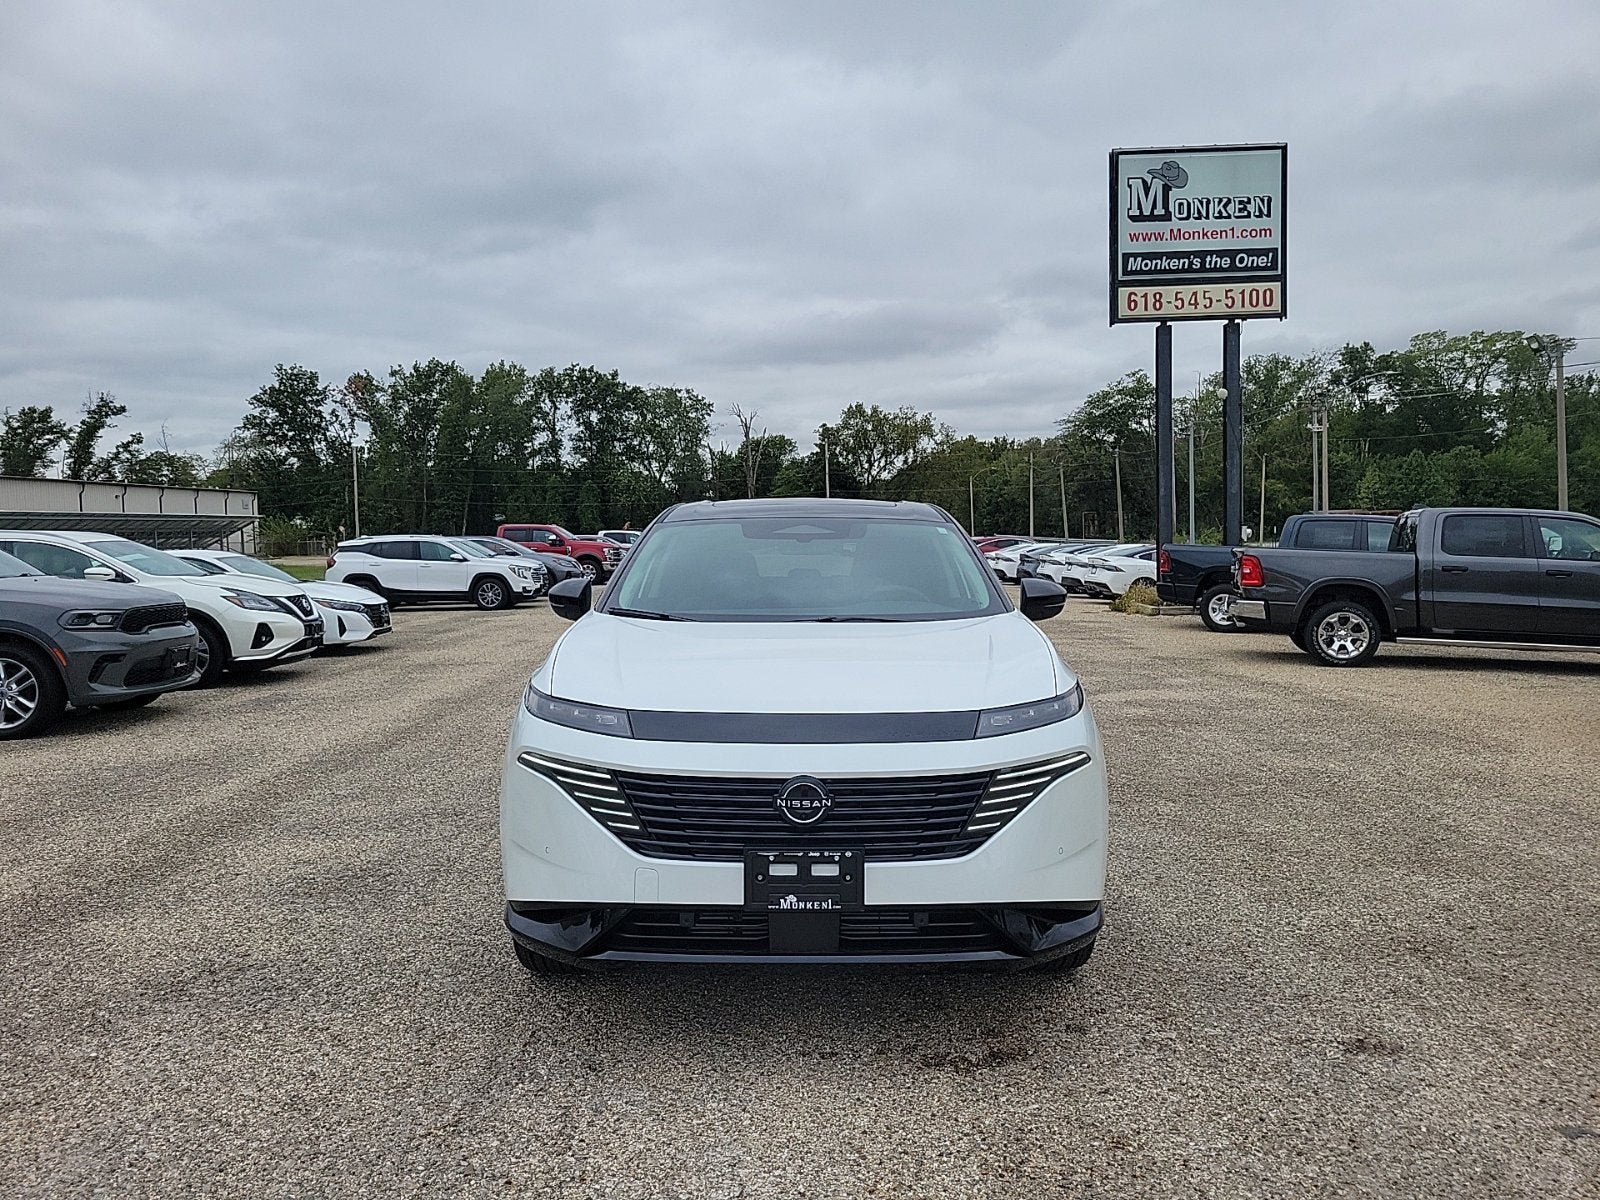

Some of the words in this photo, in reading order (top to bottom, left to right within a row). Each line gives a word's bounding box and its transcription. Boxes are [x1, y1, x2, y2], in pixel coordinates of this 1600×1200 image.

[1127, 177, 1272, 222] MONKEN
[1128, 227, 1272, 243] www.Monken1.com
[1127, 255, 1201, 271] Monken's
[1205, 255, 1231, 269] the
[1235, 253, 1273, 268] One!
[1127, 288, 1274, 312] 618-545-5100
[777, 798, 832, 808] NISSAN
